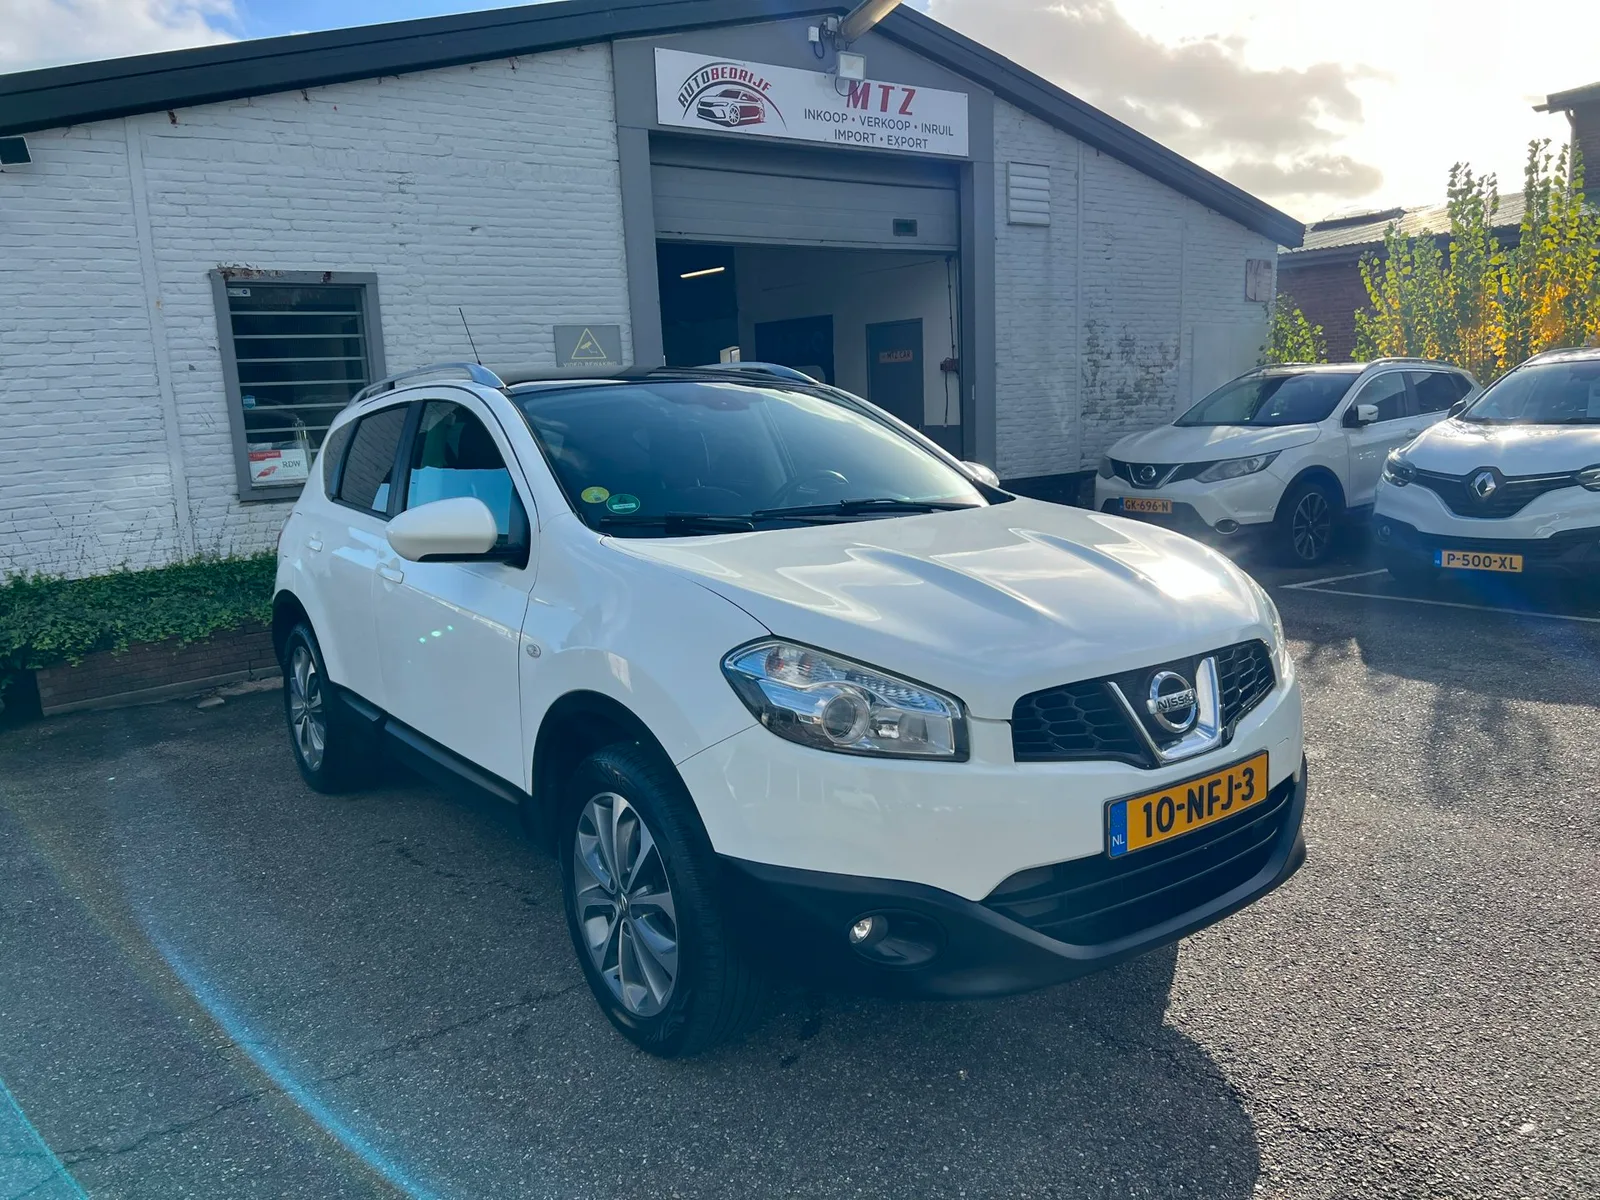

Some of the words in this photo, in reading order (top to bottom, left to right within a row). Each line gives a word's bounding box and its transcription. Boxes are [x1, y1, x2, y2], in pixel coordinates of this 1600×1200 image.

[678, 67, 772, 108] AUTOBEDRIJF
[846, 79, 916, 116] MTZ
[804, 108, 848, 123] INKOOP
[859, 115, 911, 131] VERKOOP
[921, 122, 954, 137] INRUIL
[834, 129, 876, 143] IMPORT
[887, 134, 928, 149] EXPORT
[282, 460, 301, 469] RDW
[1125, 499, 1169, 512] GK-696-N
[1447, 553, 1518, 570] P-500-XL
[1112, 833, 1125, 847] NL
[1143, 767, 1255, 838] 10-NFJ-3
